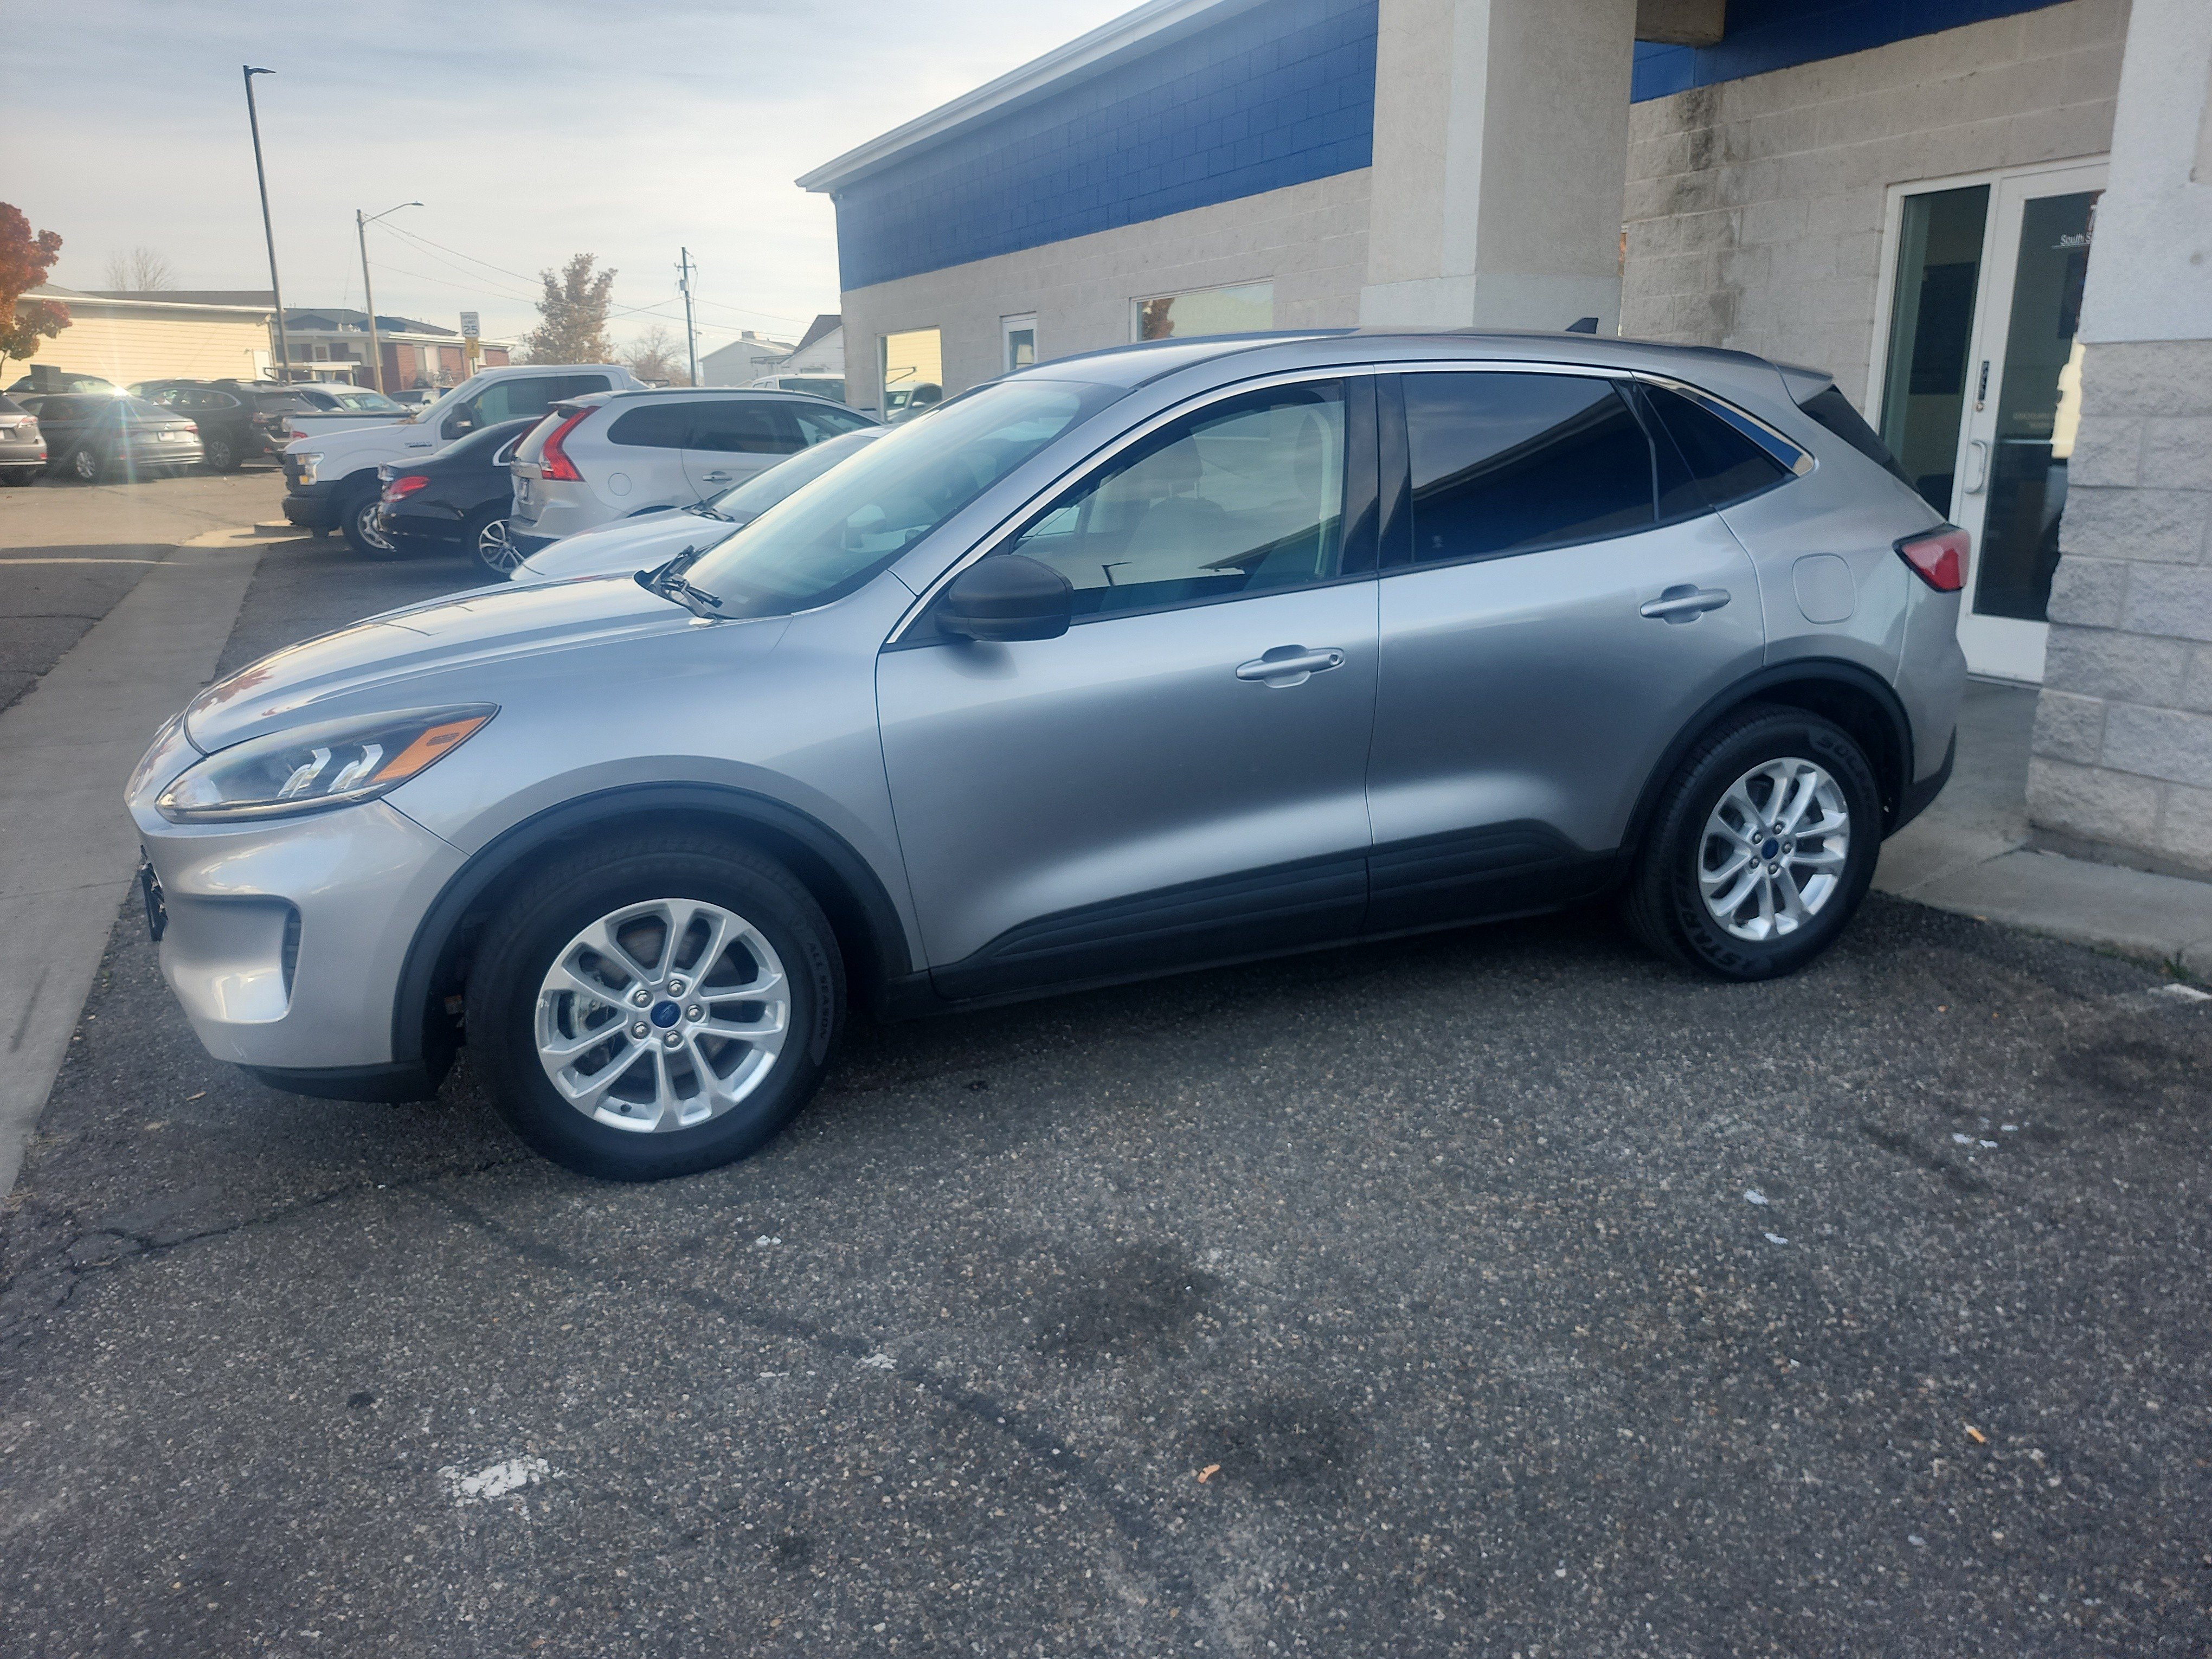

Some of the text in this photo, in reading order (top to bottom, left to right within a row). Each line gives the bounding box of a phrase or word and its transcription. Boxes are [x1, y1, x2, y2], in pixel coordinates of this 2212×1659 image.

[2060, 233, 2085, 246] South
[464, 326, 479, 335] 25
[806, 942, 830, 1039] ALL SEASON
